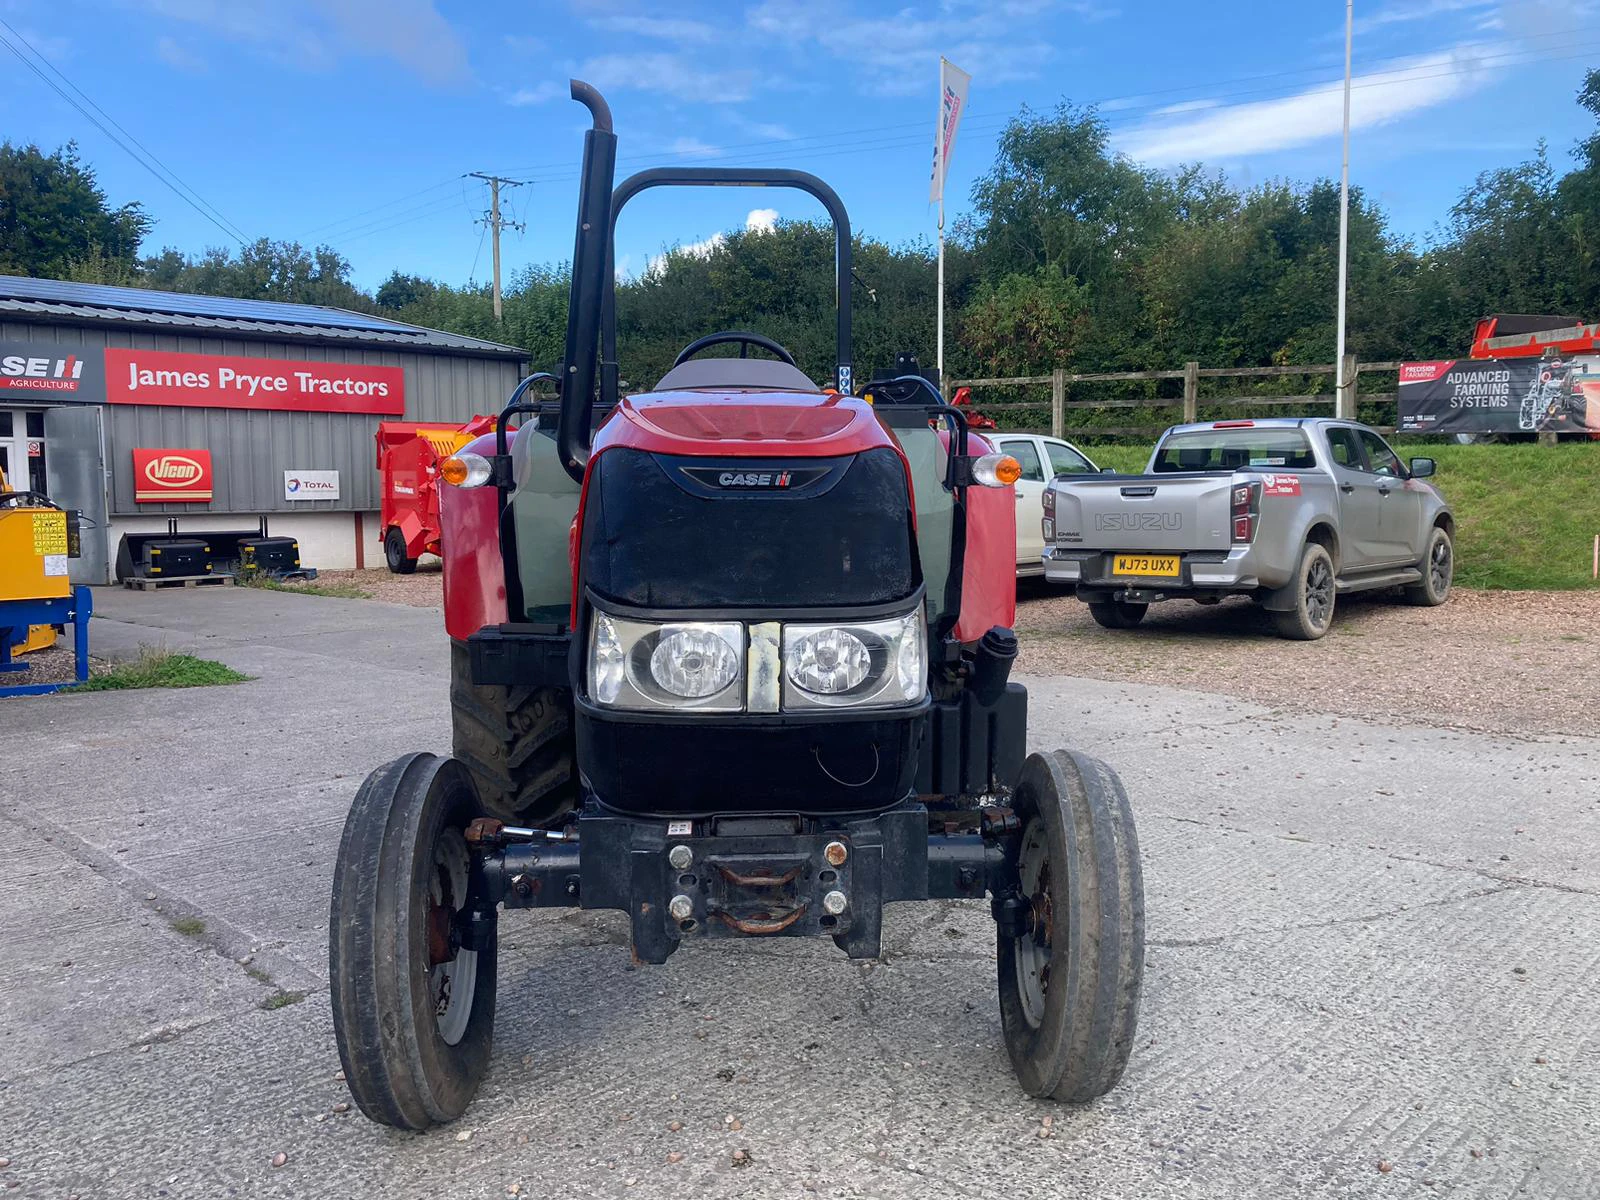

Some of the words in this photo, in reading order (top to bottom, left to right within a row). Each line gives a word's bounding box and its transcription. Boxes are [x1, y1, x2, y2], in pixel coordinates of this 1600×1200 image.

[0, 356, 50, 377] SE
[128, 362, 210, 390] James
[218, 367, 288, 396] Pryce
[294, 371, 389, 397] Tractors
[1446, 370, 1510, 384] ADVANCED
[9, 379, 75, 390] AGRICULTURE
[1455, 383, 1509, 396] FARMING
[1450, 396, 1508, 408] SYSTEMS
[153, 459, 195, 478] Vicon
[719, 473, 772, 486] CASE
[1094, 512, 1182, 531] ISUZU
[1119, 559, 1148, 571] WJ73
[1151, 559, 1175, 571] UXX
